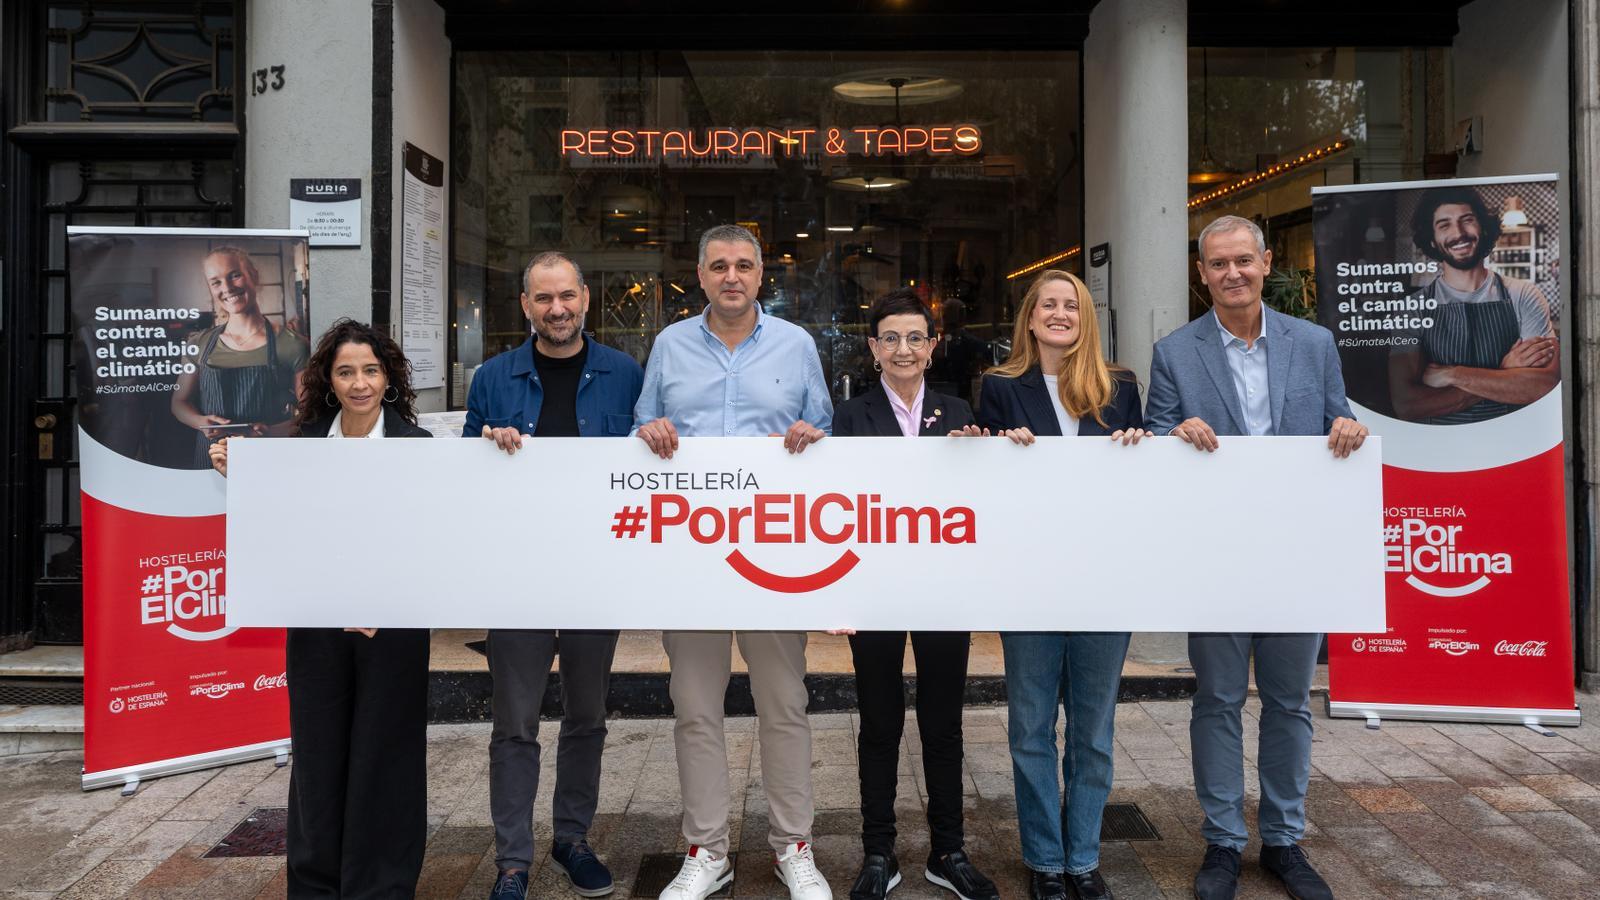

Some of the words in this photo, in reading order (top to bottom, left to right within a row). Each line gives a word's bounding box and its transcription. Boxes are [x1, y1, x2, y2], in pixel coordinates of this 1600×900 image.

[252, 64, 285, 96] 133
[561, 130, 816, 155] RESTAURANT
[825, 128, 845, 154] &
[855, 127, 980, 155] TAPES
[1336, 261, 1438, 277] Sumamos
[1337, 280, 1404, 295] contra
[1338, 298, 1358, 313] el
[1362, 295, 1438, 312] cambio
[95, 306, 200, 321] Sumamos
[1339, 314, 1434, 331] climático
[95, 325, 166, 340] contra
[96, 343, 117, 358] el
[122, 341, 200, 358] cambio
[1338, 337, 1419, 347] #SúmateAlCero
[96, 360, 196, 377] climático
[96, 383, 181, 394] #SúmateAlCero
[610, 469, 760, 490] HOSTELERÍA
[610, 492, 977, 544] #PorElClima
[1383, 518, 1463, 546] #Por
[139, 548, 227, 568] HOSTELERÍA
[1384, 545, 1512, 574] ElClima
[141, 565, 223, 594] #Por
[141, 589, 227, 625] ElCli
[1368, 637, 1407, 645] HOSTELERÍA
[1494, 639, 1549, 656] Coca-Cola
[128, 690, 168, 703] HOSTELERÍA
[190, 682, 245, 696] #PorElClima
[128, 703, 137, 711] DE
